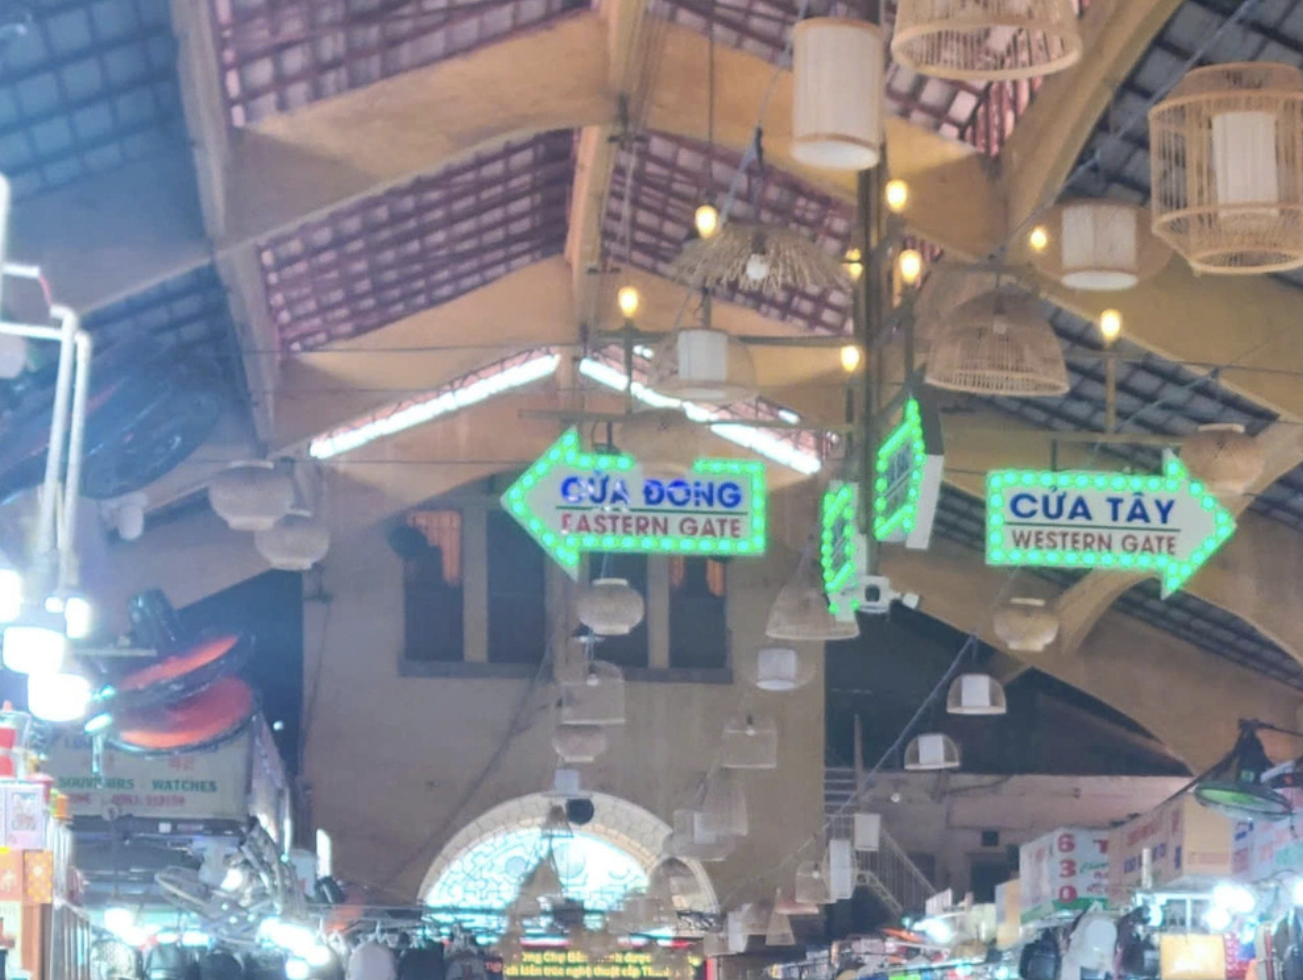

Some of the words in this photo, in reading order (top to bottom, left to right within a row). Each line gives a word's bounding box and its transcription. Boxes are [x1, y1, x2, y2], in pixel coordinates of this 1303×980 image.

[560, 468, 630, 505] CỬA
[1009, 485, 1092, 521] CỬA
[1106, 491, 1175, 524] TÂY
[561, 513, 669, 537] EASTERN
[678, 516, 741, 539] GATE
[1012, 529, 1112, 551] WESTERN
[1121, 533, 1176, 556] GATE
